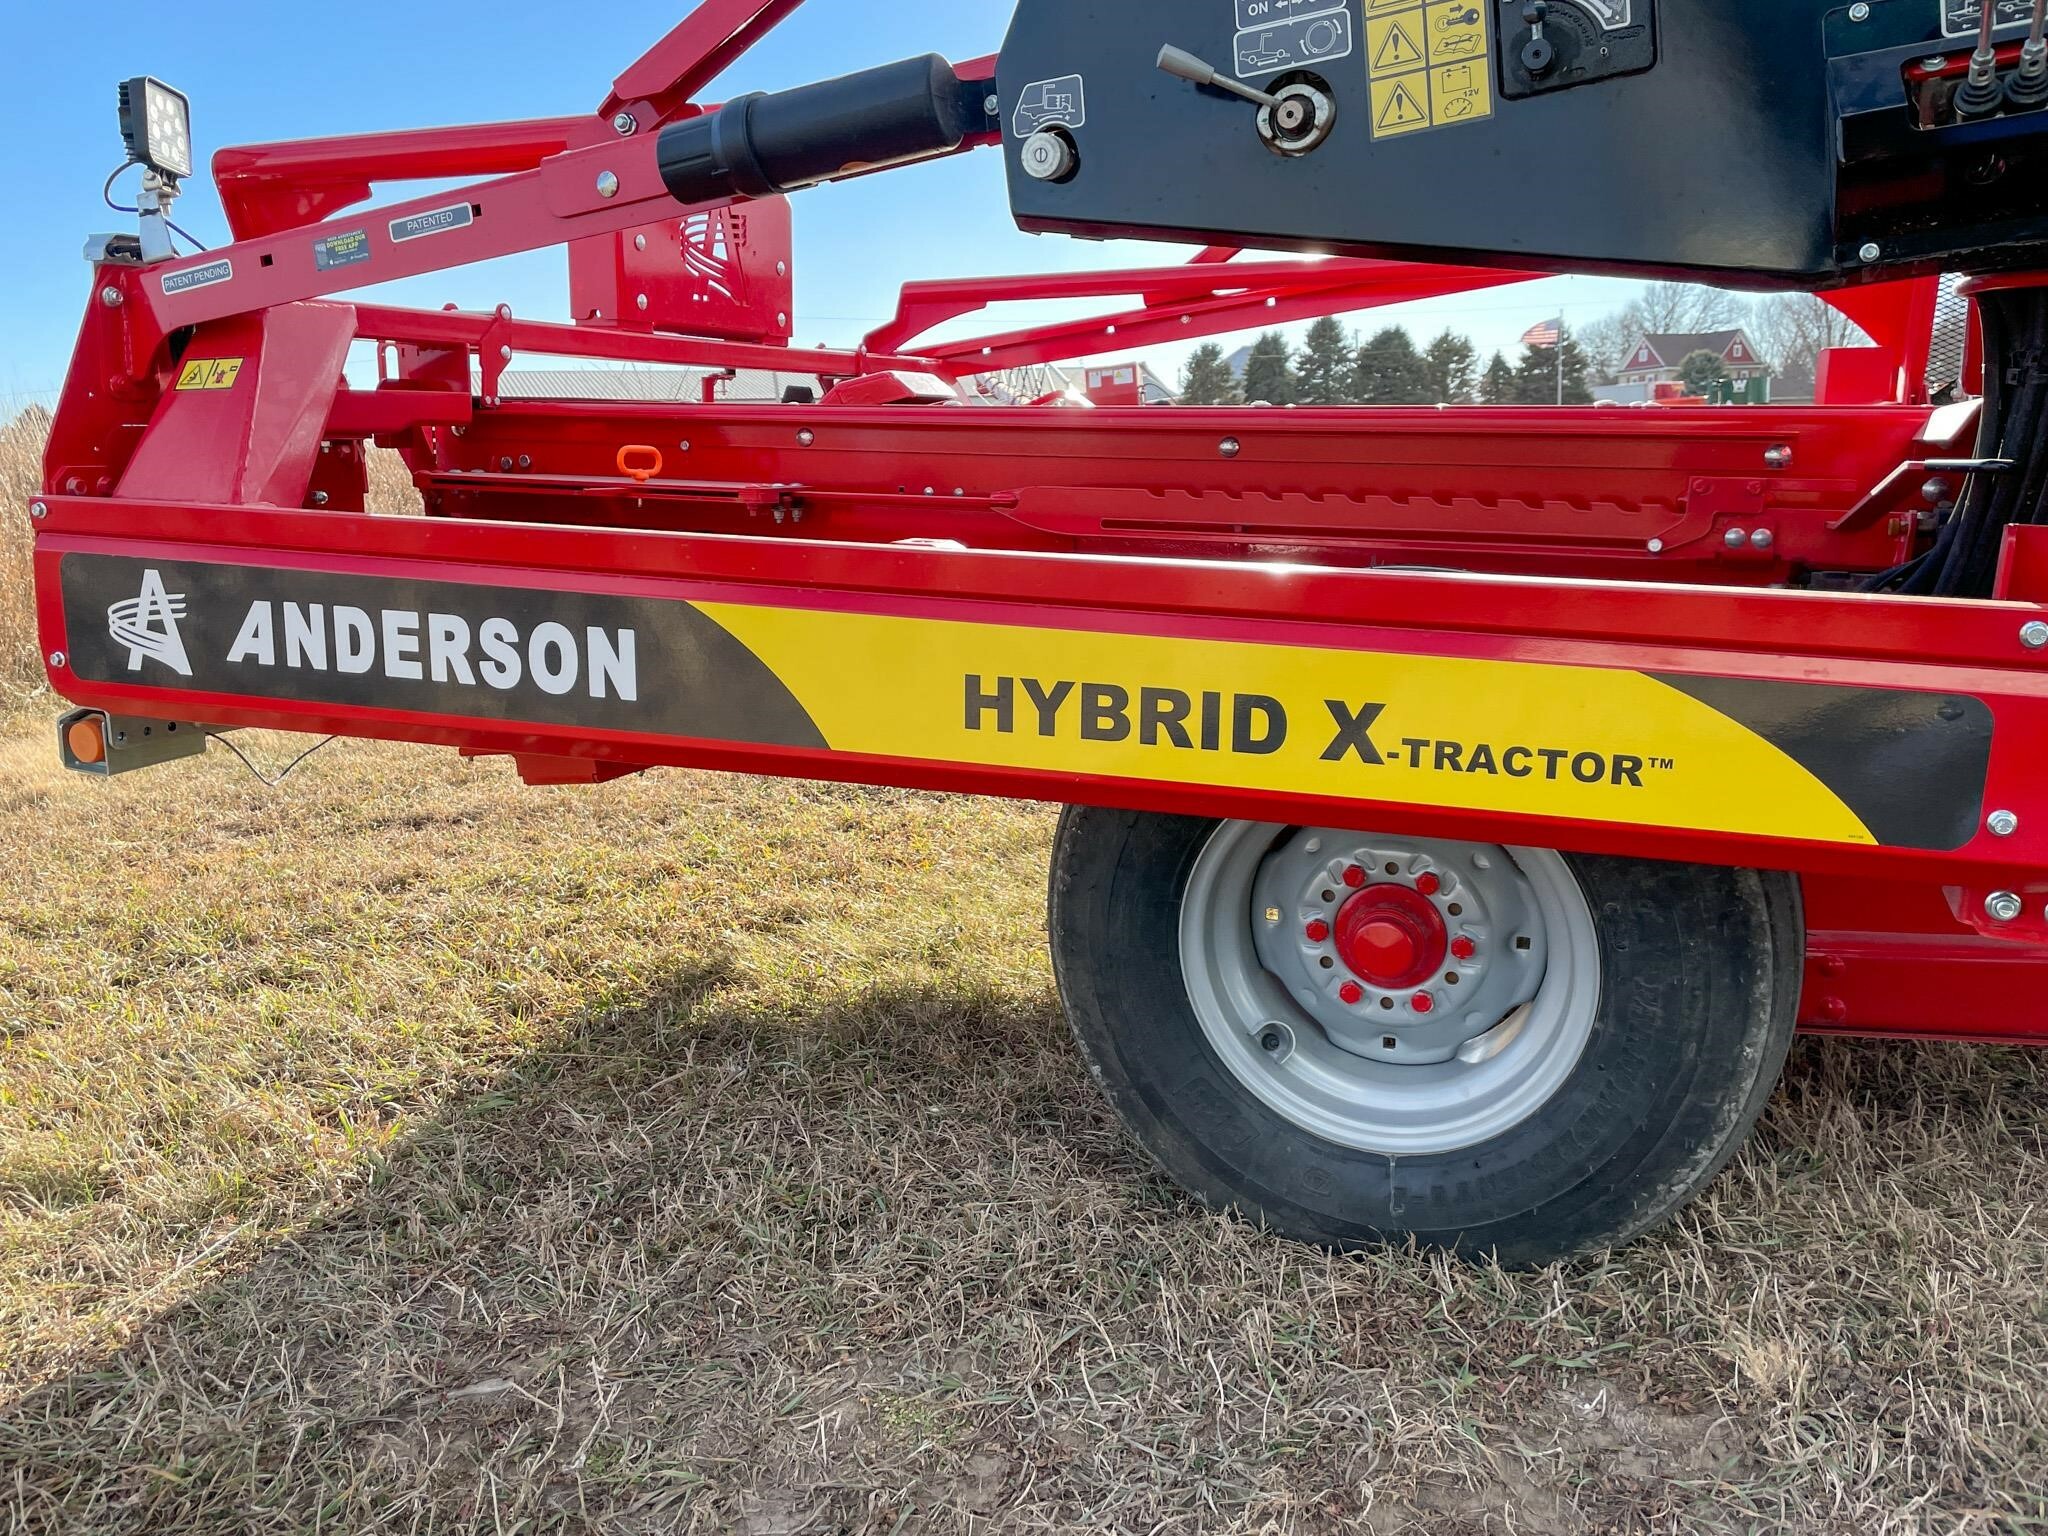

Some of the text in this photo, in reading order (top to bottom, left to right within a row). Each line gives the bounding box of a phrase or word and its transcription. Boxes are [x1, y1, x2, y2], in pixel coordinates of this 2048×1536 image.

[1248, 0, 1269, 16] ON
[1463, 88, 1480, 98] 12V
[407, 211, 454, 231] PATENTED
[326, 237, 355, 248] DOWNLOAD
[165, 265, 229, 289] PATENT PENDING
[226, 600, 639, 702] ANDERSON
[964, 673, 1288, 755] HYBRID
